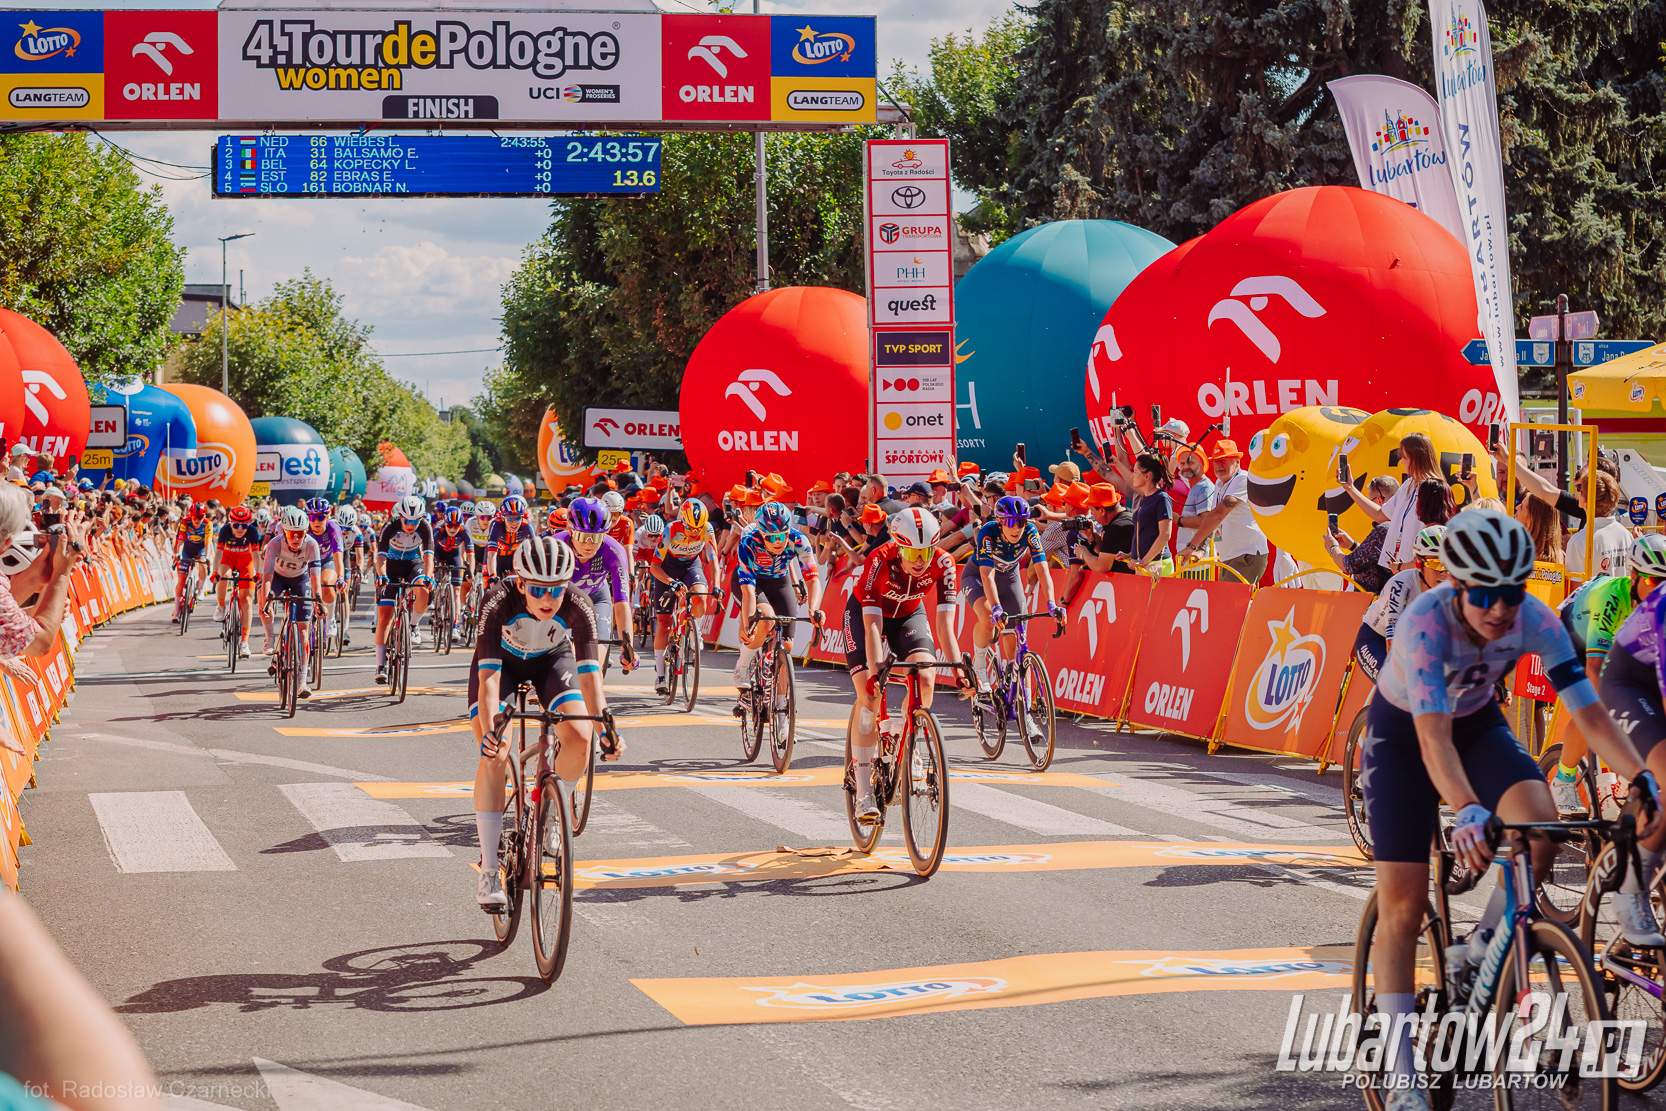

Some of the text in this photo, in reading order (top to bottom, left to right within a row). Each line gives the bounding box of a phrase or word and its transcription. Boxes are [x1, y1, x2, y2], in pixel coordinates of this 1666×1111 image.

[27, 33, 68, 54] LOTTO
[803, 37, 843, 58] LOTTO
[277, 66, 402, 91] women
[15, 92, 85, 103] LANGTEAM
[122, 83, 201, 101] ORLEN
[529, 87, 560, 100] UCI
[678, 85, 755, 103] ORLEN
[792, 95, 859, 106] LANGTEAM
[407, 98, 474, 119] FINISH
[225, 137, 233, 147] 1
[260, 137, 288, 147] NED
[310, 137, 327, 147] 66
[334, 137, 385, 147] WIEBES
[388, 137, 400, 147] L.
[225, 148, 552, 158] 2 ITA 31 BALSAMO E. +0
[566, 142, 660, 162] 2:43:57
[225, 160, 552, 170] 3 BEL 64 KOPECKY L. +0
[224, 171, 552, 182] 4 EST 82 EBRAS E. +0
[612, 170, 656, 186] 13.6
[225, 182, 232, 193] 5
[260, 182, 288, 193] SLO
[302, 182, 327, 193] 161
[332, 182, 394, 193] BOBNAR
[534, 182, 551, 193] +0
[902, 226, 942, 235] GRUPA
[897, 268, 925, 279] PHH
[888, 294, 937, 316] quest
[884, 343, 943, 354] TVP SPORT
[1197, 379, 1339, 418] ORLEN
[906, 413, 944, 426] onet
[624, 422, 680, 437] ORLEN
[718, 431, 798, 451] ORLEN
[84, 453, 111, 465] 25m
[176, 454, 221, 476] LOTTO
[885, 454, 945, 465] SPORTOWY
[1055, 667, 1105, 706] ORLEN
[1265, 654, 1312, 706] LOTTO
[1527, 681, 1546, 695] Stage 2
[1144, 682, 1194, 721] ORLEN
[600, 865, 716, 878] LOTTO
[1186, 962, 1325, 975] LOTTO
[808, 982, 953, 1004] LOTTO
